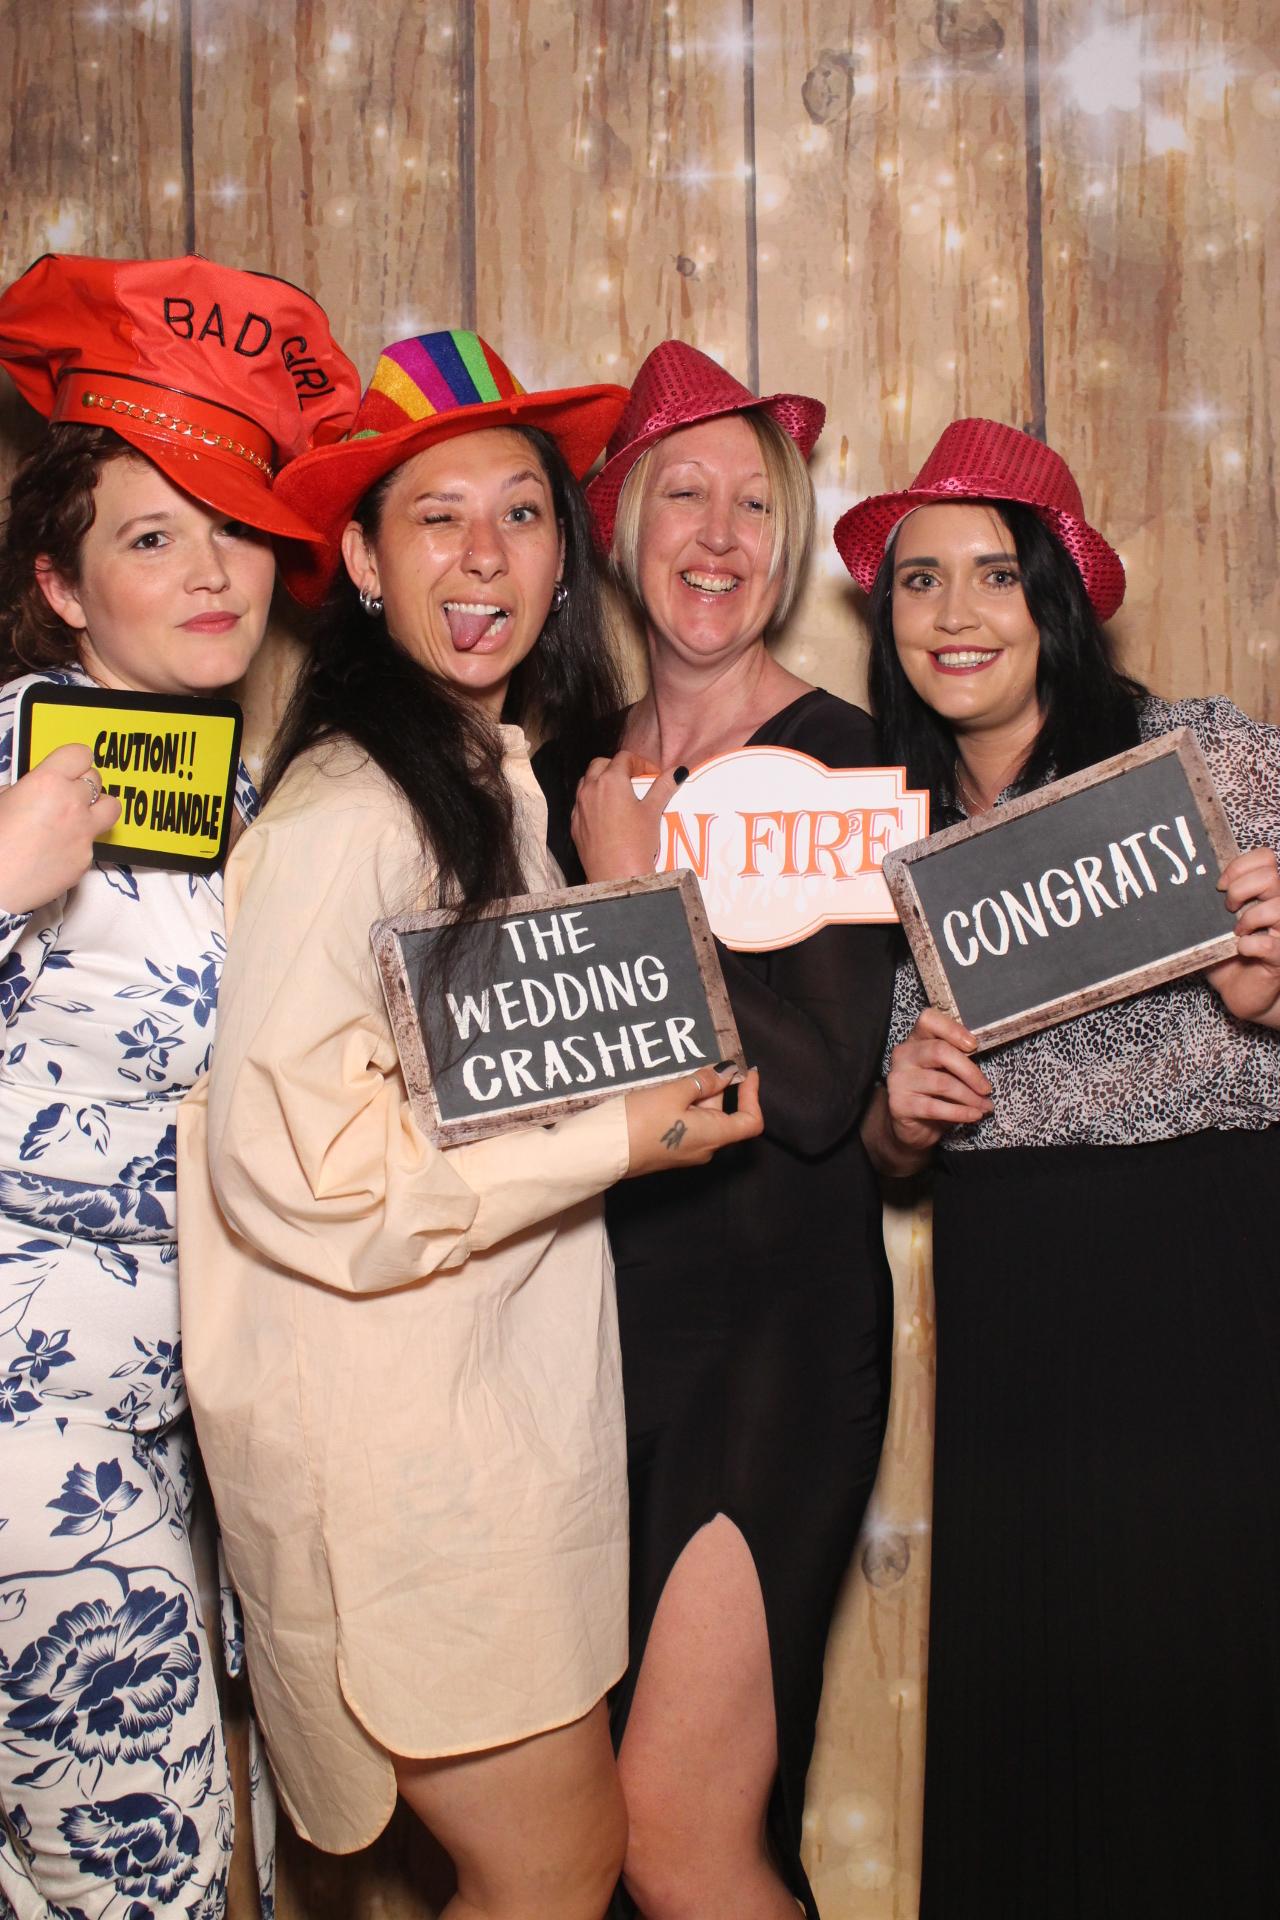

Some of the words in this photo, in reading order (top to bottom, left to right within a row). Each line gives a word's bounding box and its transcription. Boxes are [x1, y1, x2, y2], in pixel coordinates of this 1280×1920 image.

[164, 297, 272, 357] BAD
[281, 335, 335, 411] GIRL
[94, 730, 197, 781] CAUTION!!
[124, 786, 148, 827] TO
[150, 789, 222, 840] HANDLE
[654, 811, 718, 880] N
[735, 807, 903, 882] FIRE
[943, 815, 1206, 967] CONGRATS!
[501, 911, 596, 963] THE
[446, 955, 669, 1040] WEDDING
[462, 1017, 708, 1101] CRASHER
